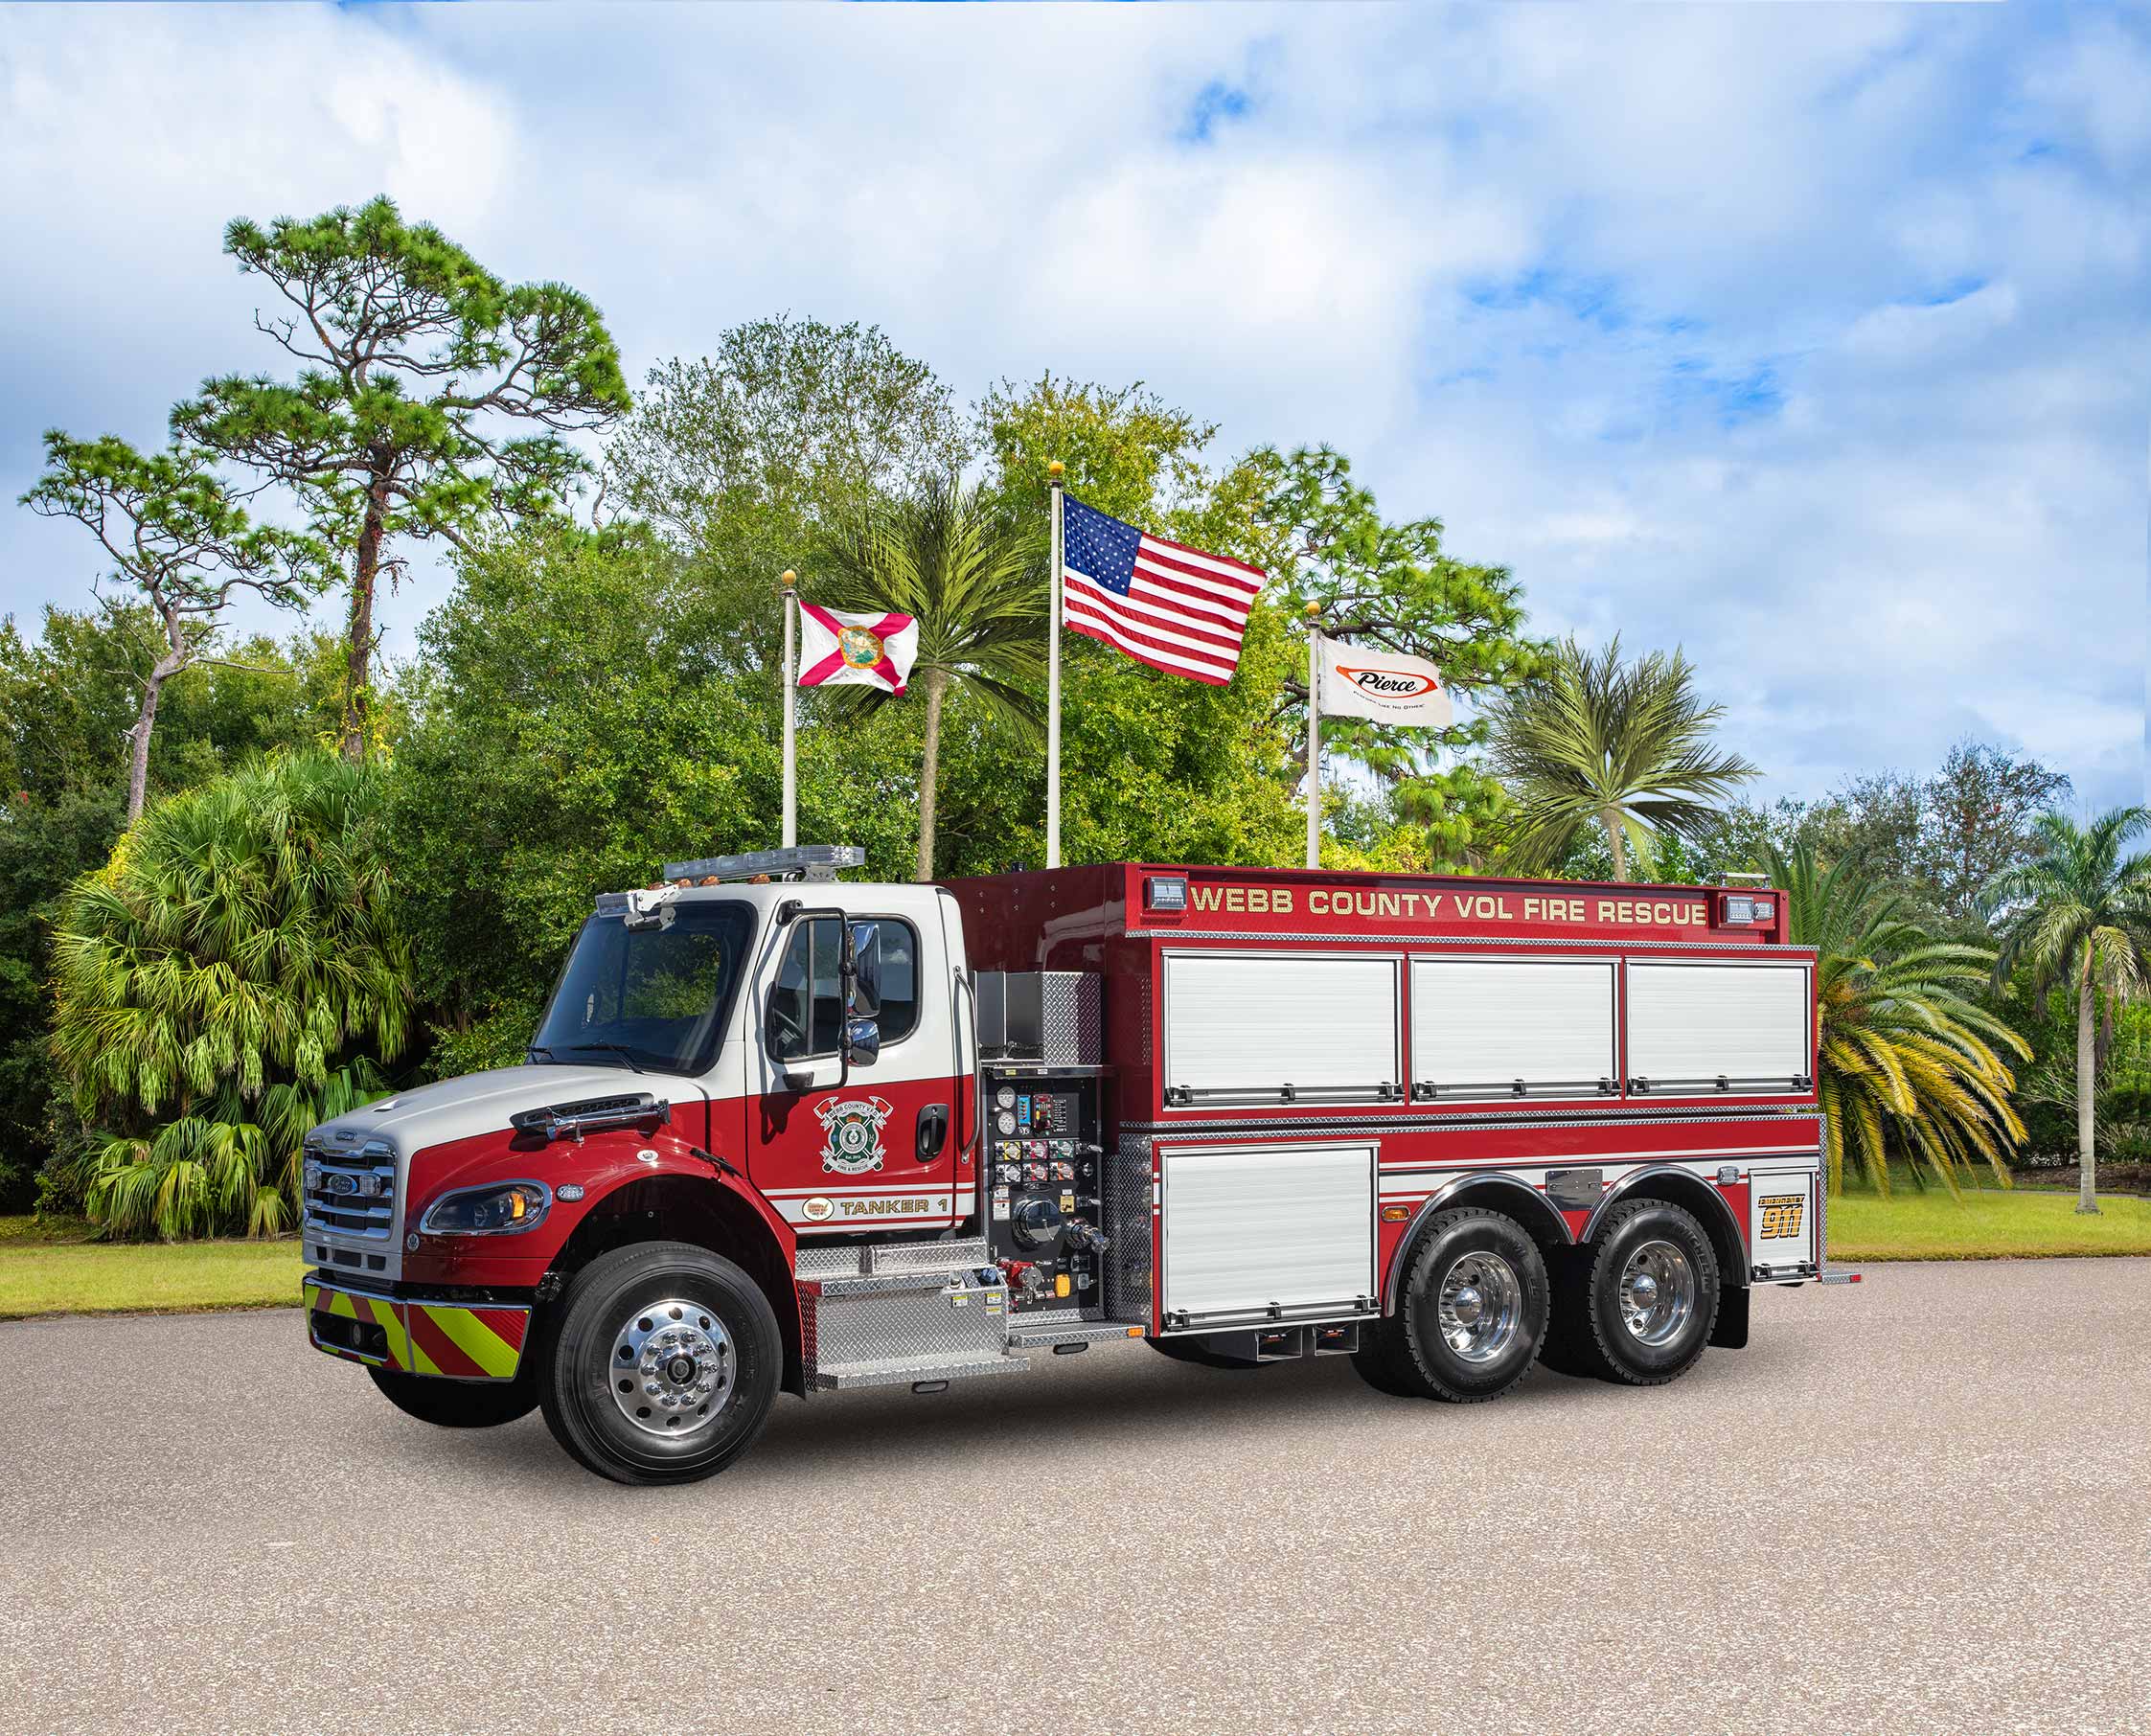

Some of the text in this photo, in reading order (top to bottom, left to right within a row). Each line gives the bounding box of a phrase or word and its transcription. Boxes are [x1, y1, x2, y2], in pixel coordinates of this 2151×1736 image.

[1358, 672, 1416, 692] Pierce
[1190, 887, 1706, 925] WEBB COUNTY VOL FIRE RESCUE
[829, 1106, 843, 1118] WEBB
[840, 1199, 929, 1216] TANKER
[938, 1199, 948, 1212] 1
[1760, 1206, 1803, 1240] 911
[1674, 1221, 1710, 1293] MICHELIN
